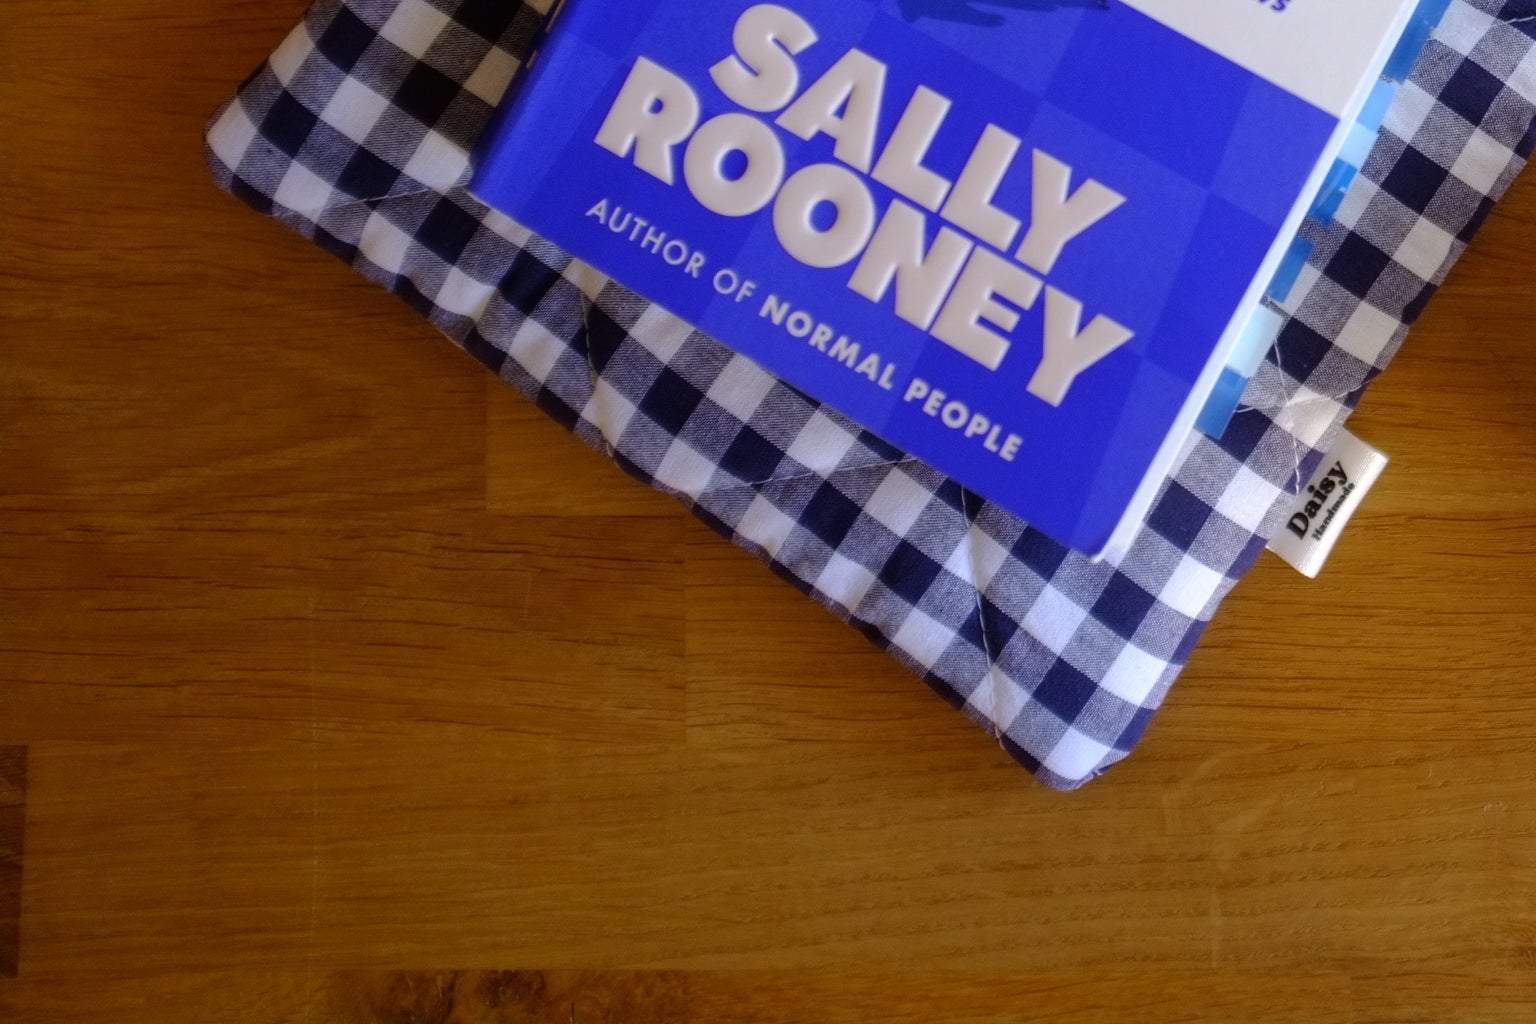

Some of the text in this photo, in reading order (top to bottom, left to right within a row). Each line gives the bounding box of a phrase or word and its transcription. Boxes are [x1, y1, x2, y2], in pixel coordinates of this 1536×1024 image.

[594, 55, 1135, 408] ROONEY
[709, 3, 1127, 276] SALLY
[585, 198, 1023, 461] AUTHOR OF NORMAL PEOPLE
[1286, 460, 1348, 540] Daisy
[1312, 483, 1355, 541] Handmade
